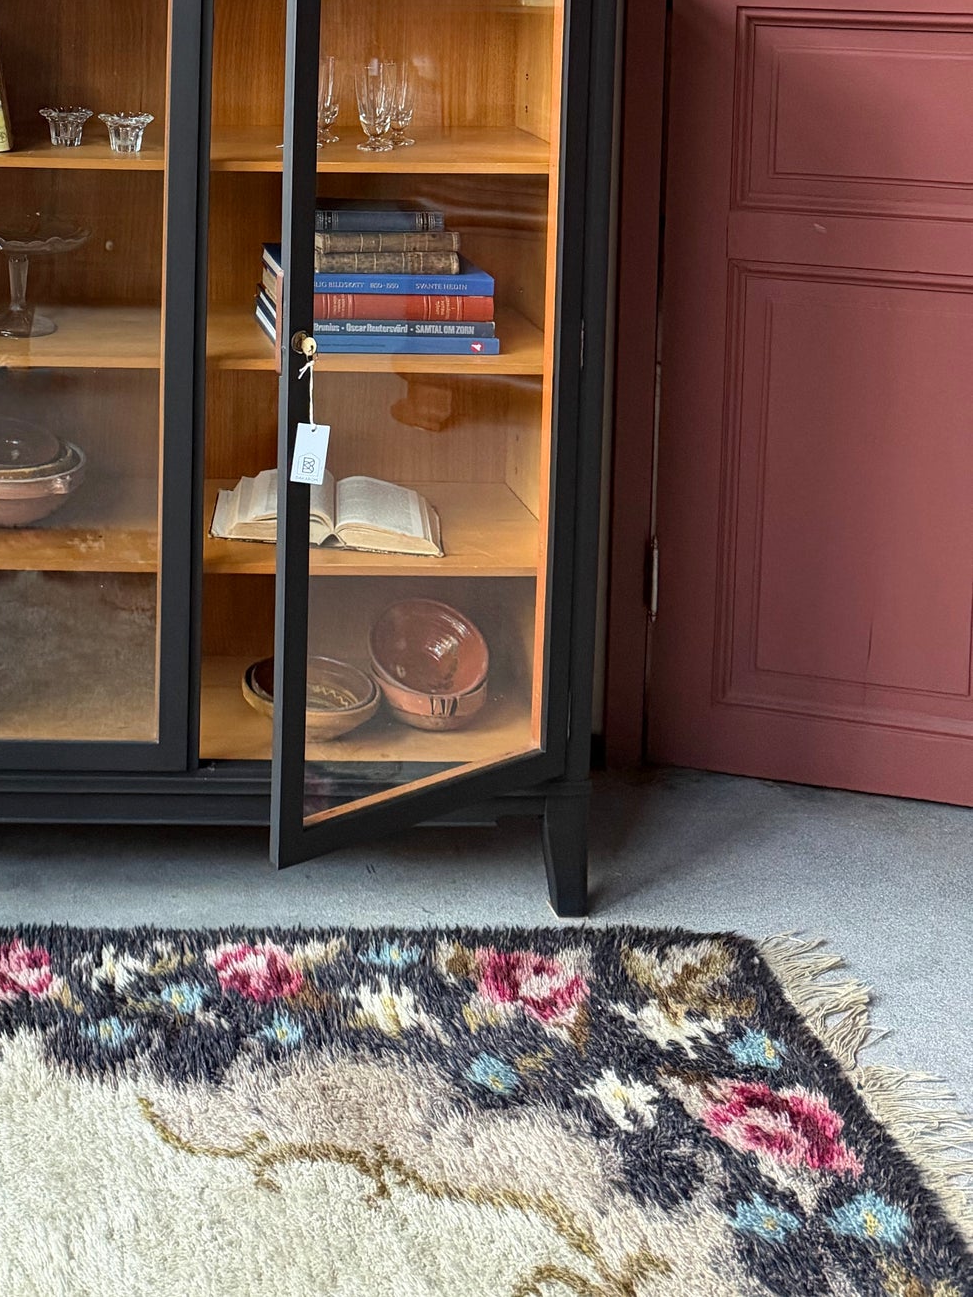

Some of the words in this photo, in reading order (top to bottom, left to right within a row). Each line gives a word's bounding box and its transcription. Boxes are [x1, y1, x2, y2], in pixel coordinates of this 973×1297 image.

[345, 323, 366, 333] Oscar
[415, 324, 443, 334] SAMTAL
[443, 325, 455, 334] OM
[455, 325, 475, 335] ZORN
